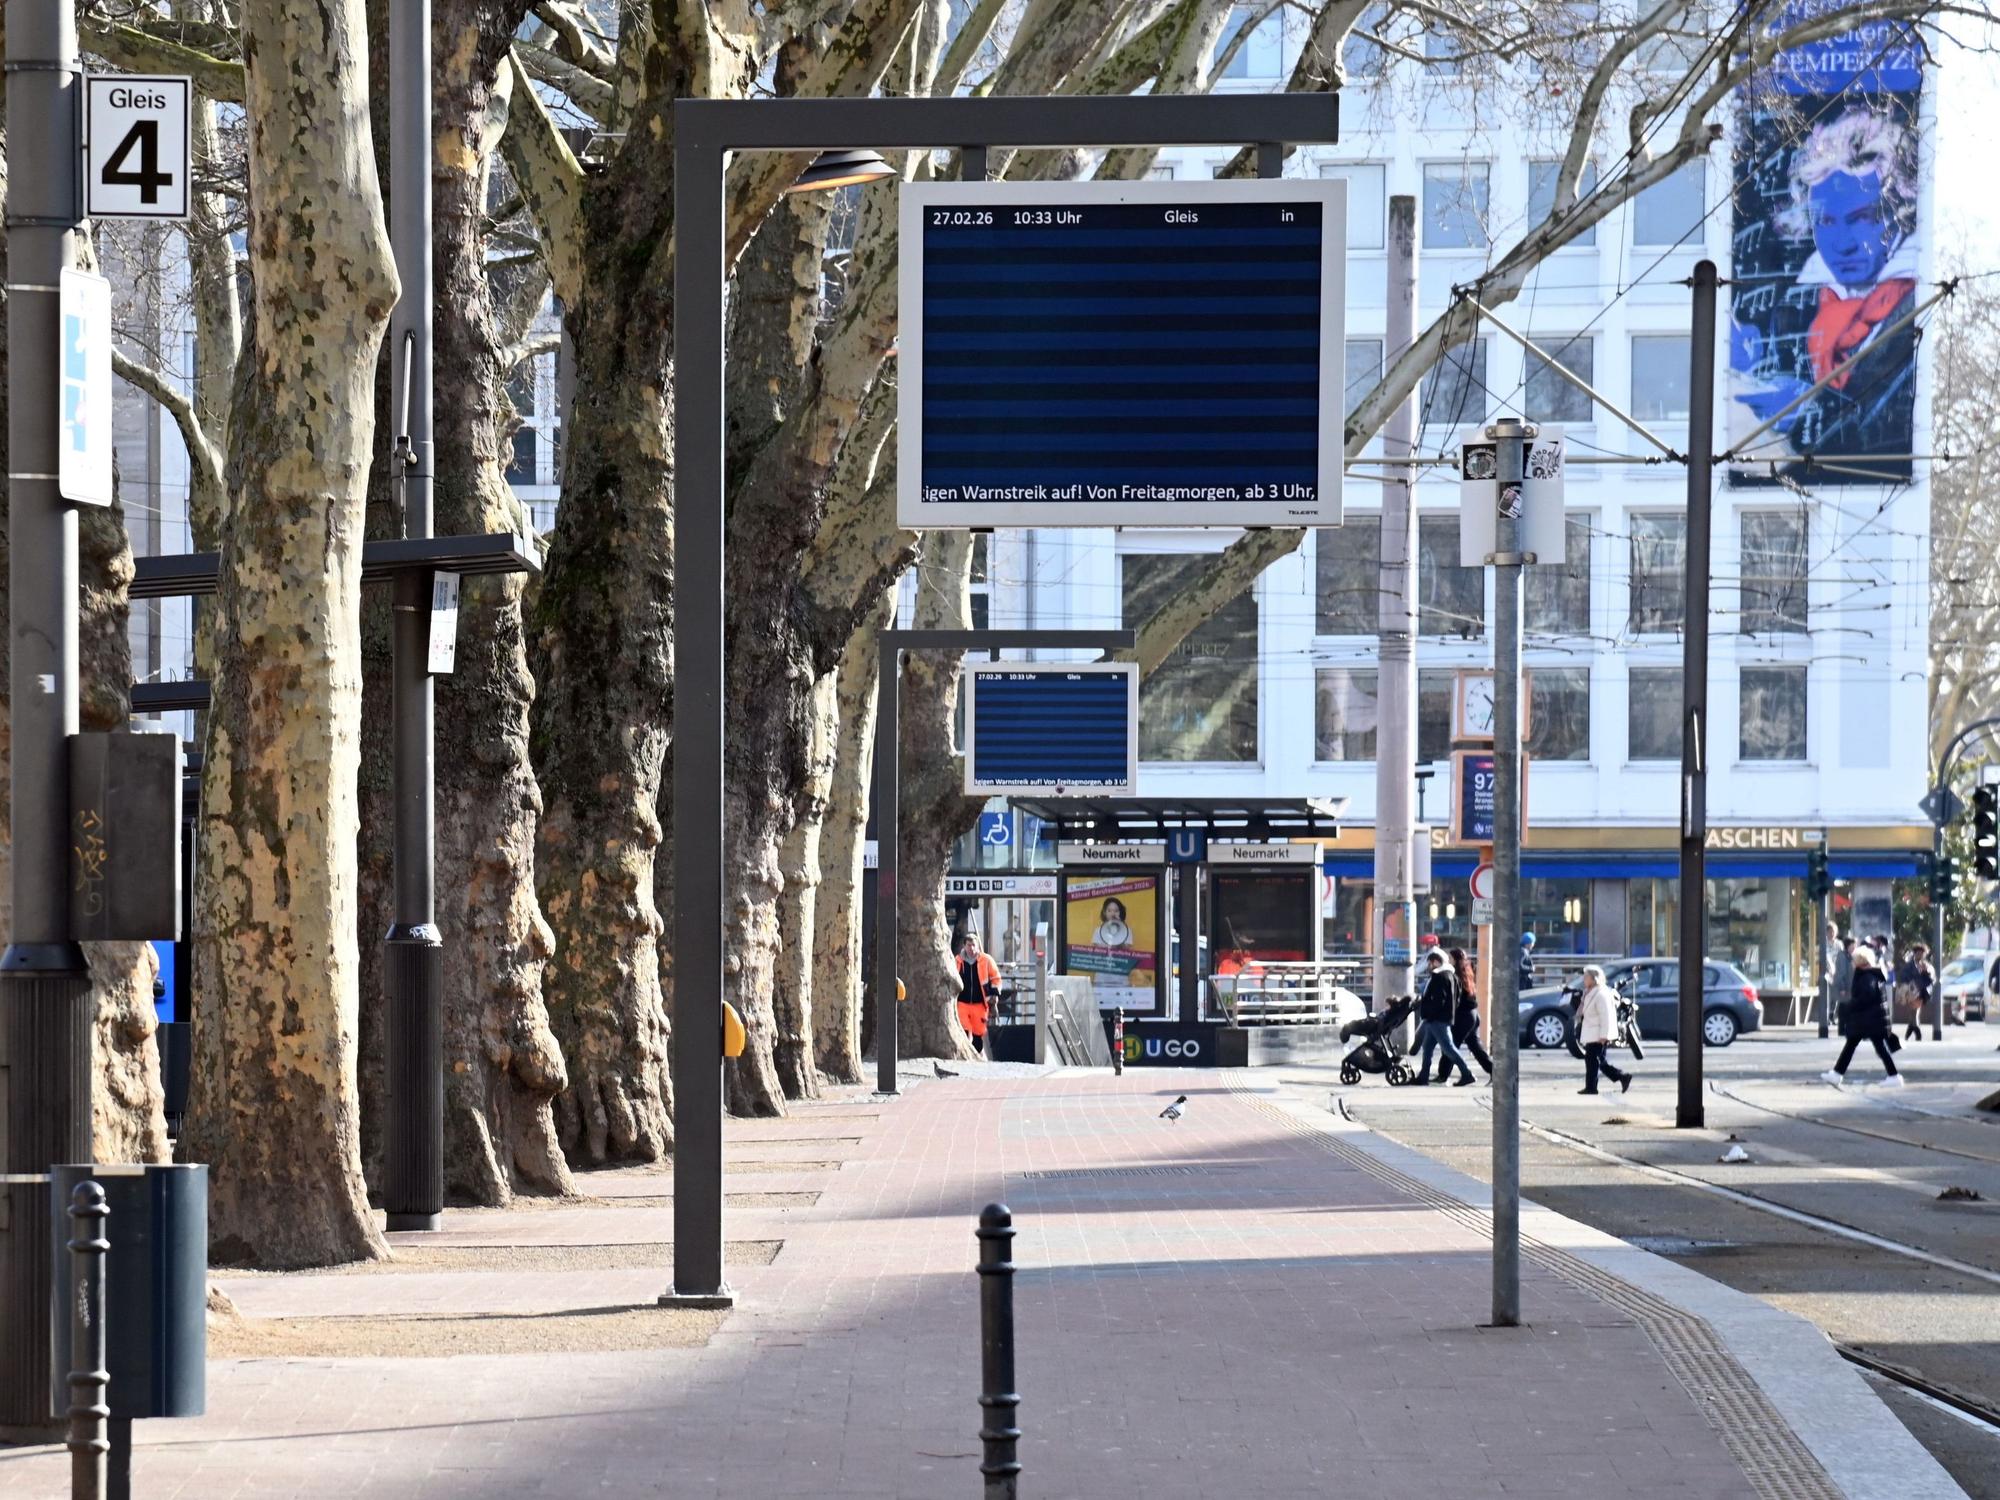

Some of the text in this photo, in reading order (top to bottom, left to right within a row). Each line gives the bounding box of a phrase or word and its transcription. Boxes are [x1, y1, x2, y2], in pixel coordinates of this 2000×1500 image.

[109, 88, 166, 109] Gleis
[101, 120, 173, 204] 4
[933, 209, 1294, 225] 27.02.26 10:33 Uhr Gleis in
[923, 484, 1315, 502] igen Warnstreik auf! Von Freitagmorgen, ab 3 Uhr,
[979, 673, 1002, 681] 27.02.26
[1025, 673, 1036, 681] Uhr
[1067, 673, 1081, 681] Gleis
[996, 778, 1028, 786] Warnstreik
[1043, 778, 1055, 786] Von
[1104, 778, 1113, 786] ab
[1176, 832, 1194, 857] U
[1705, 828, 1797, 848] ASCHEN
[1082, 848, 1140, 859] Neumarkt
[1233, 847, 1289, 859] Neumarkt
